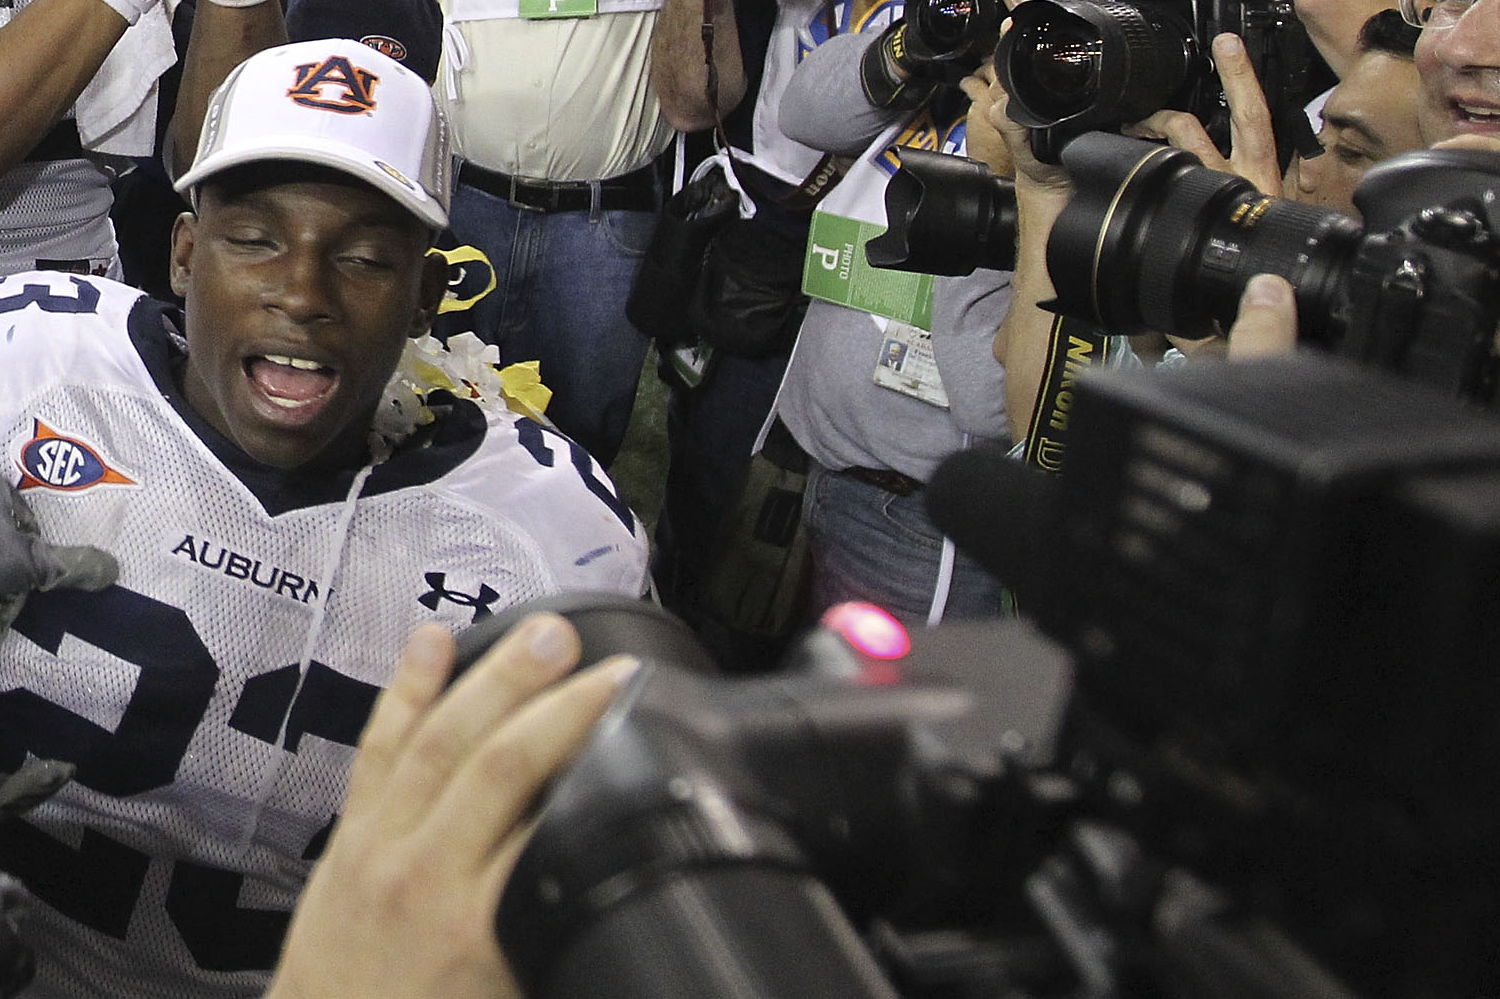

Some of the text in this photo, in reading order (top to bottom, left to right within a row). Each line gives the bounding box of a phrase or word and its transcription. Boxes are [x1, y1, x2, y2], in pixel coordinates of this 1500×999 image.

[286, 54, 382, 116] AU
[812, 242, 840, 271] P
[838, 242, 854, 281] PHOTO
[36, 439, 85, 487] SEC
[172, 534, 336, 613] AUBURN
